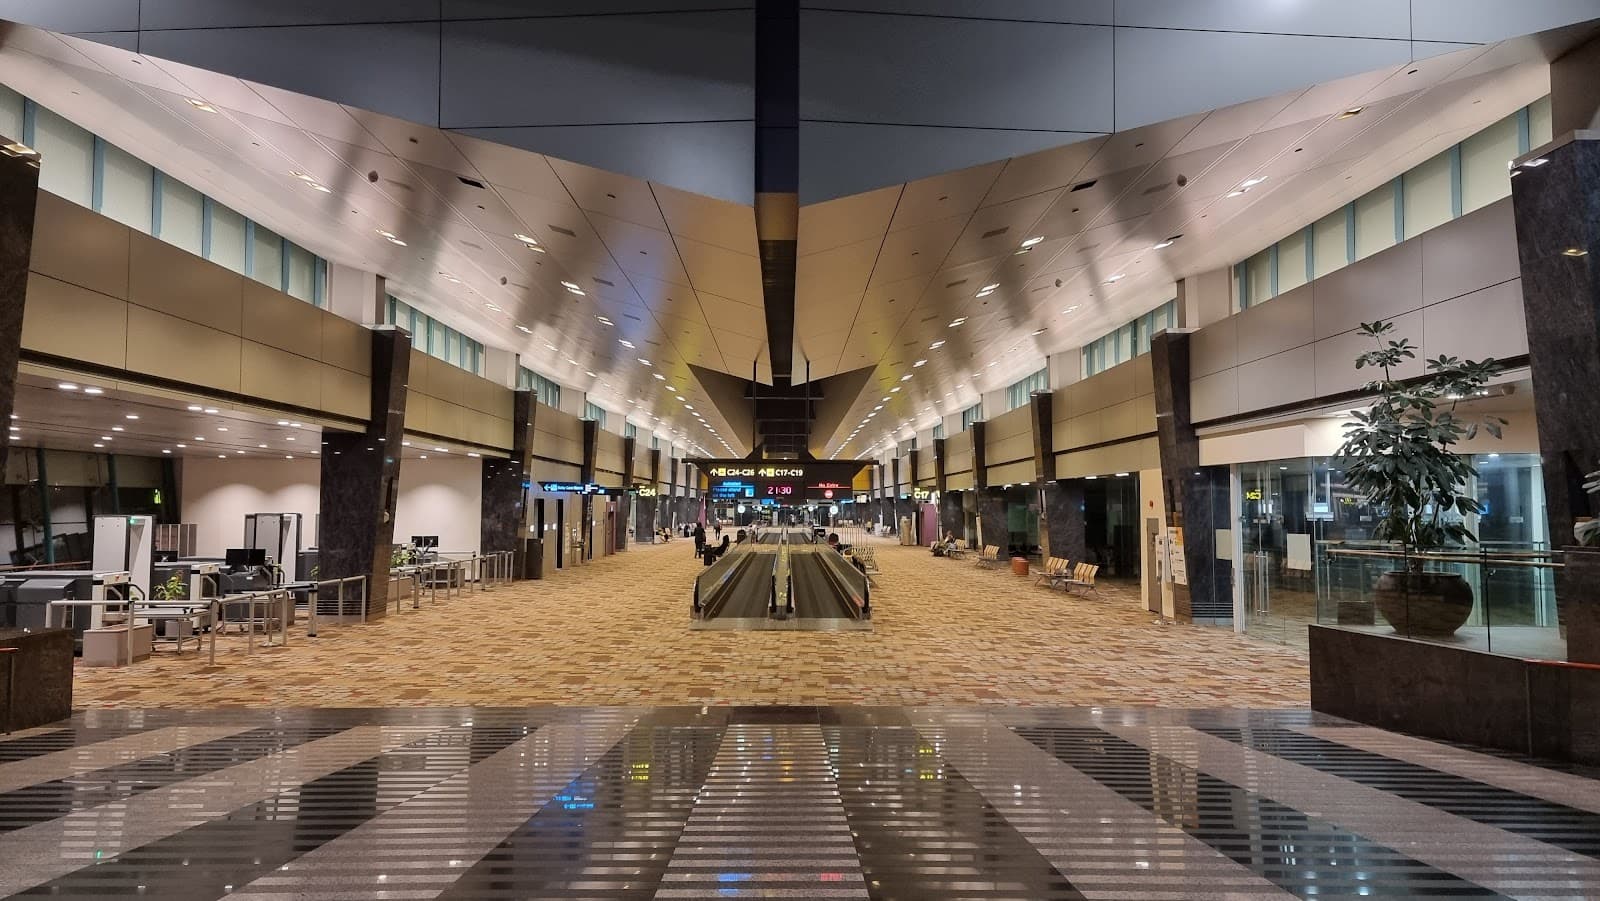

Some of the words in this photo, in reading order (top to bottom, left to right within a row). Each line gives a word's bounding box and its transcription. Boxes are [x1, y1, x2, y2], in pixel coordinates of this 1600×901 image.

[727, 468, 755, 476] C24-C26
[775, 469, 803, 477] C17-C19
[639, 488, 656, 496] C24
[767, 486, 792, 495] 21:30
[914, 491, 930, 499] C17
